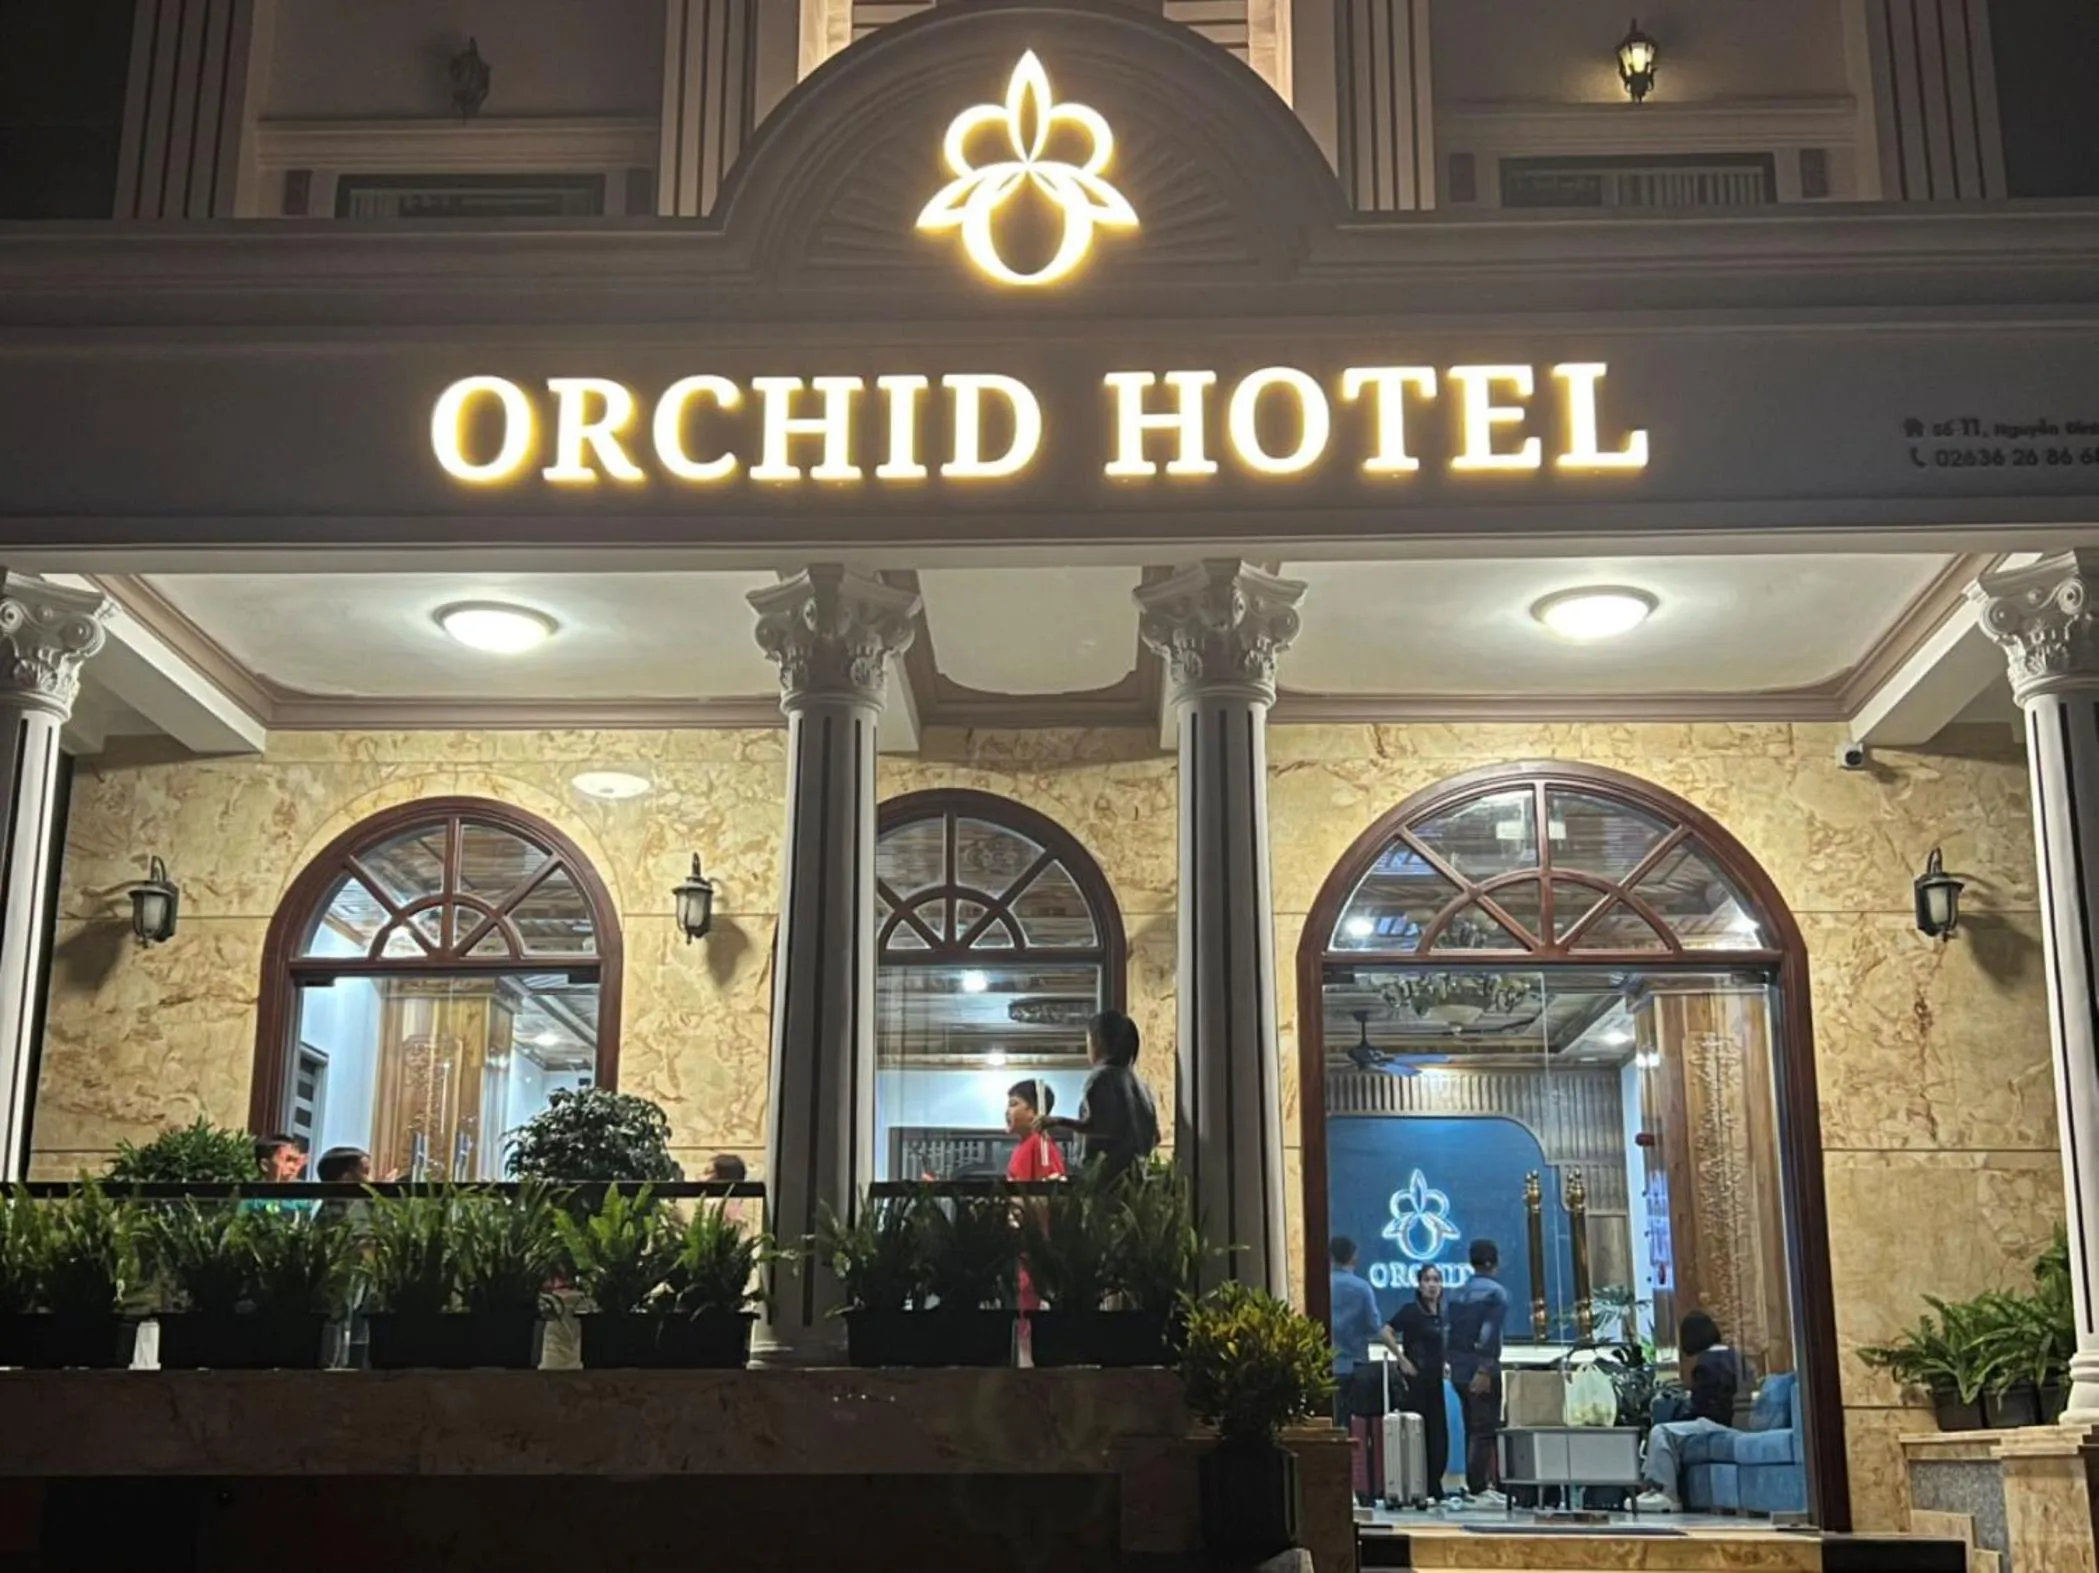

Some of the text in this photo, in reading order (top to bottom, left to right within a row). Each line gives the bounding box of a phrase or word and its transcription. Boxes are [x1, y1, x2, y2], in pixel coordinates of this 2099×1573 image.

[430, 362, 1649, 482] ORCHID HOTEL
[1935, 448, 2006, 467] 02636
[2012, 448, 2039, 466] 26
[2045, 447, 2074, 466] 86
